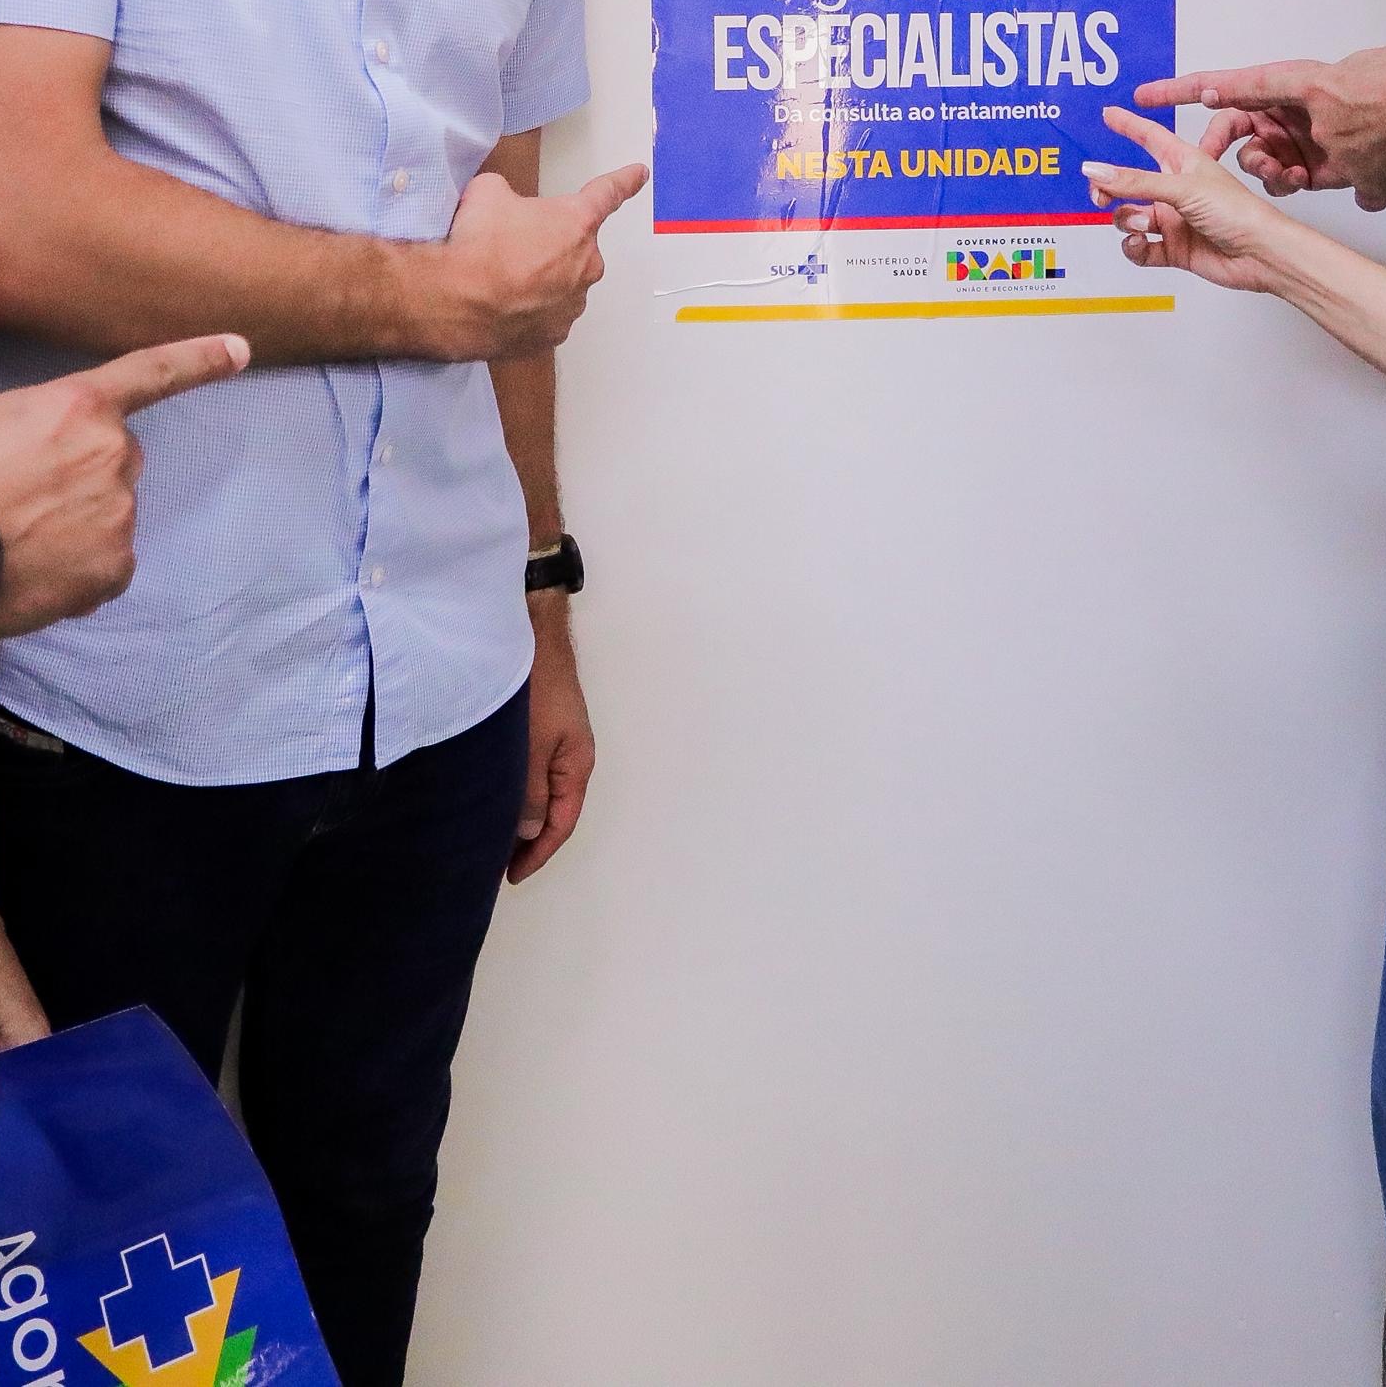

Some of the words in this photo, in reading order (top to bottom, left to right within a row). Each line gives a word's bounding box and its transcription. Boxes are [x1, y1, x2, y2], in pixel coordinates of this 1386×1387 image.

[713, 10, 1120, 91] ESPECIALISTAS
[774, 104, 804, 123] Da
[808, 103, 903, 123] consulta
[907, 106, 935, 122] ao
[939, 101, 1062, 121] tratamento
[776, 149, 893, 180] NESTA
[900, 147, 1061, 178] UNIDADE
[956, 238, 1006, 246] GOVERNO
[1010, 237, 1057, 245] FEDERAL
[846, 256, 910, 266] MINISTÉRIO
[914, 256, 928, 265] DA
[947, 249, 1066, 282] BRASIL
[770, 265, 796, 277] SUS
[892, 267, 928, 277] SAÚDE
[992, 284, 1056, 293] RECONSTRUÇÃO
